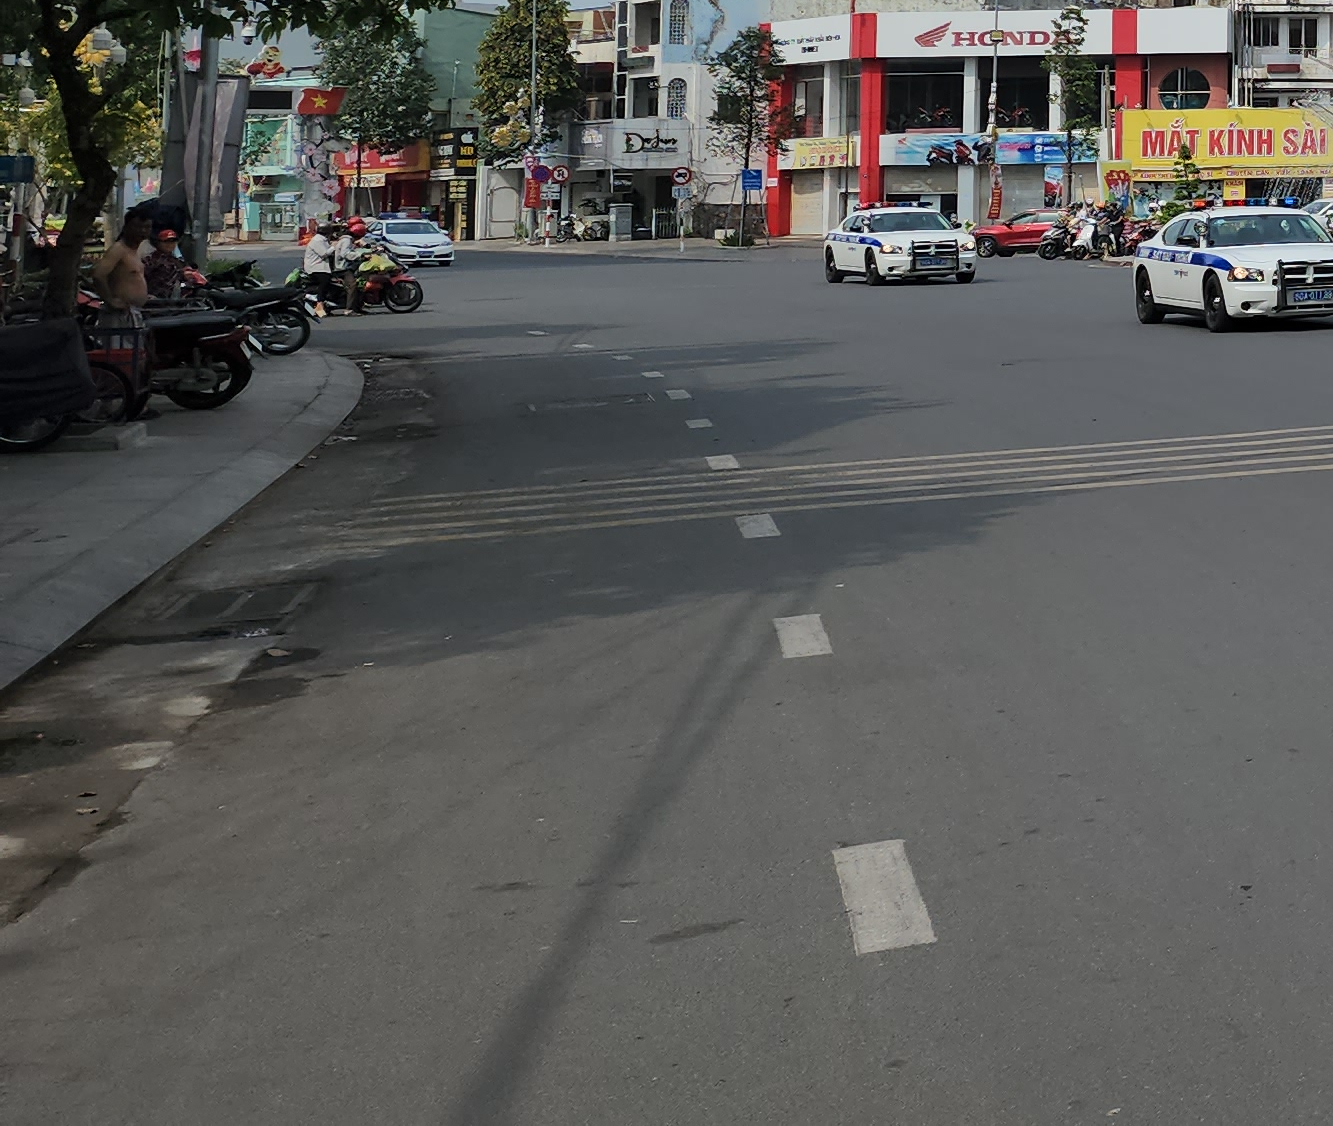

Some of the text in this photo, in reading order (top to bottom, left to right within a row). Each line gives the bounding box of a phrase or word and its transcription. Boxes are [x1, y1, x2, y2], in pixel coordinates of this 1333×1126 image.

[951, 30, 1074, 47] HONDA
[1208, 120, 1274, 157] KÍNH
[1282, 121, 1326, 156] SÀI
